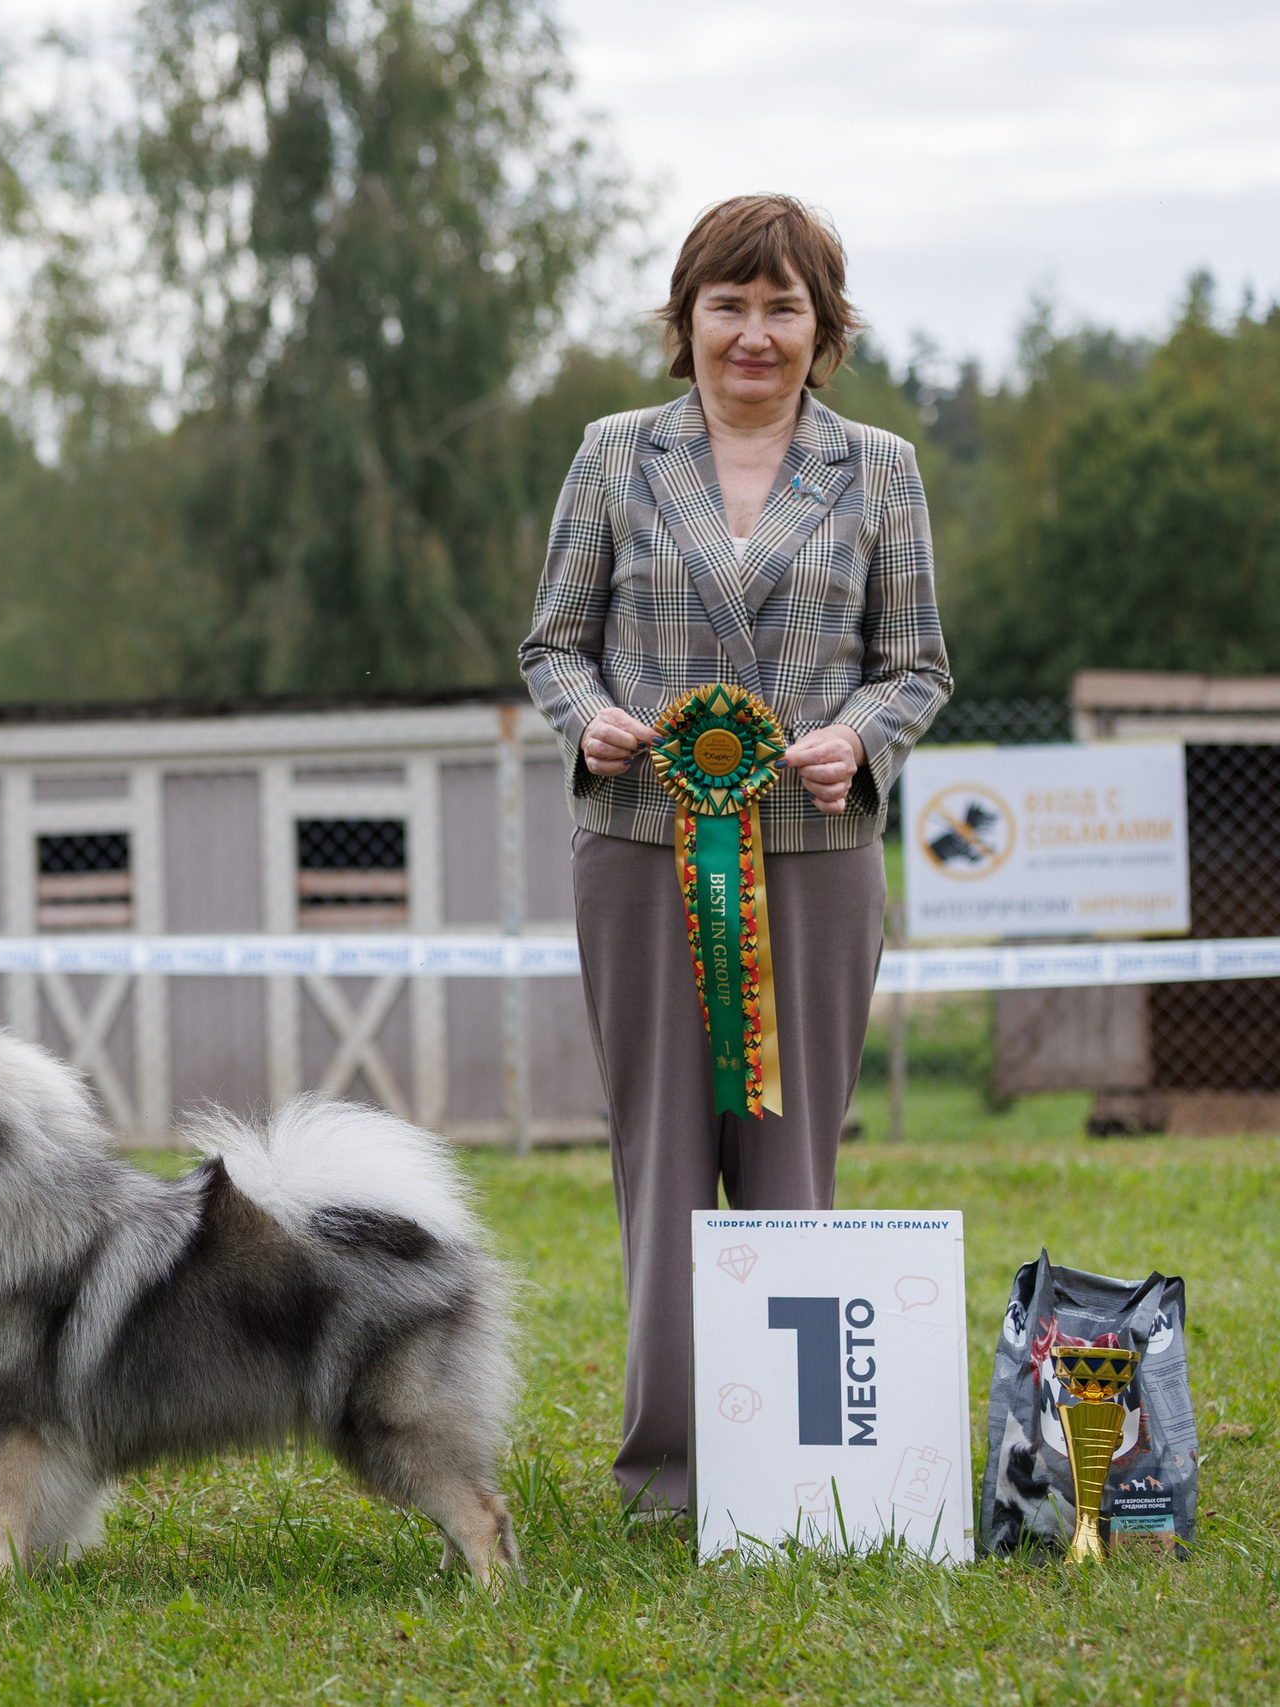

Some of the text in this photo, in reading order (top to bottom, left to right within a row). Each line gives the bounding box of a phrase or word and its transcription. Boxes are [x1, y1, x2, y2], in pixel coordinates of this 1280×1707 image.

[710, 872, 731, 1006] BEST IN GROUP
[706, 1220, 949, 1230] SUPREME QUALITY MADE IN GERMANY
[768, 1296, 878, 1446] 1 МЕСТО
